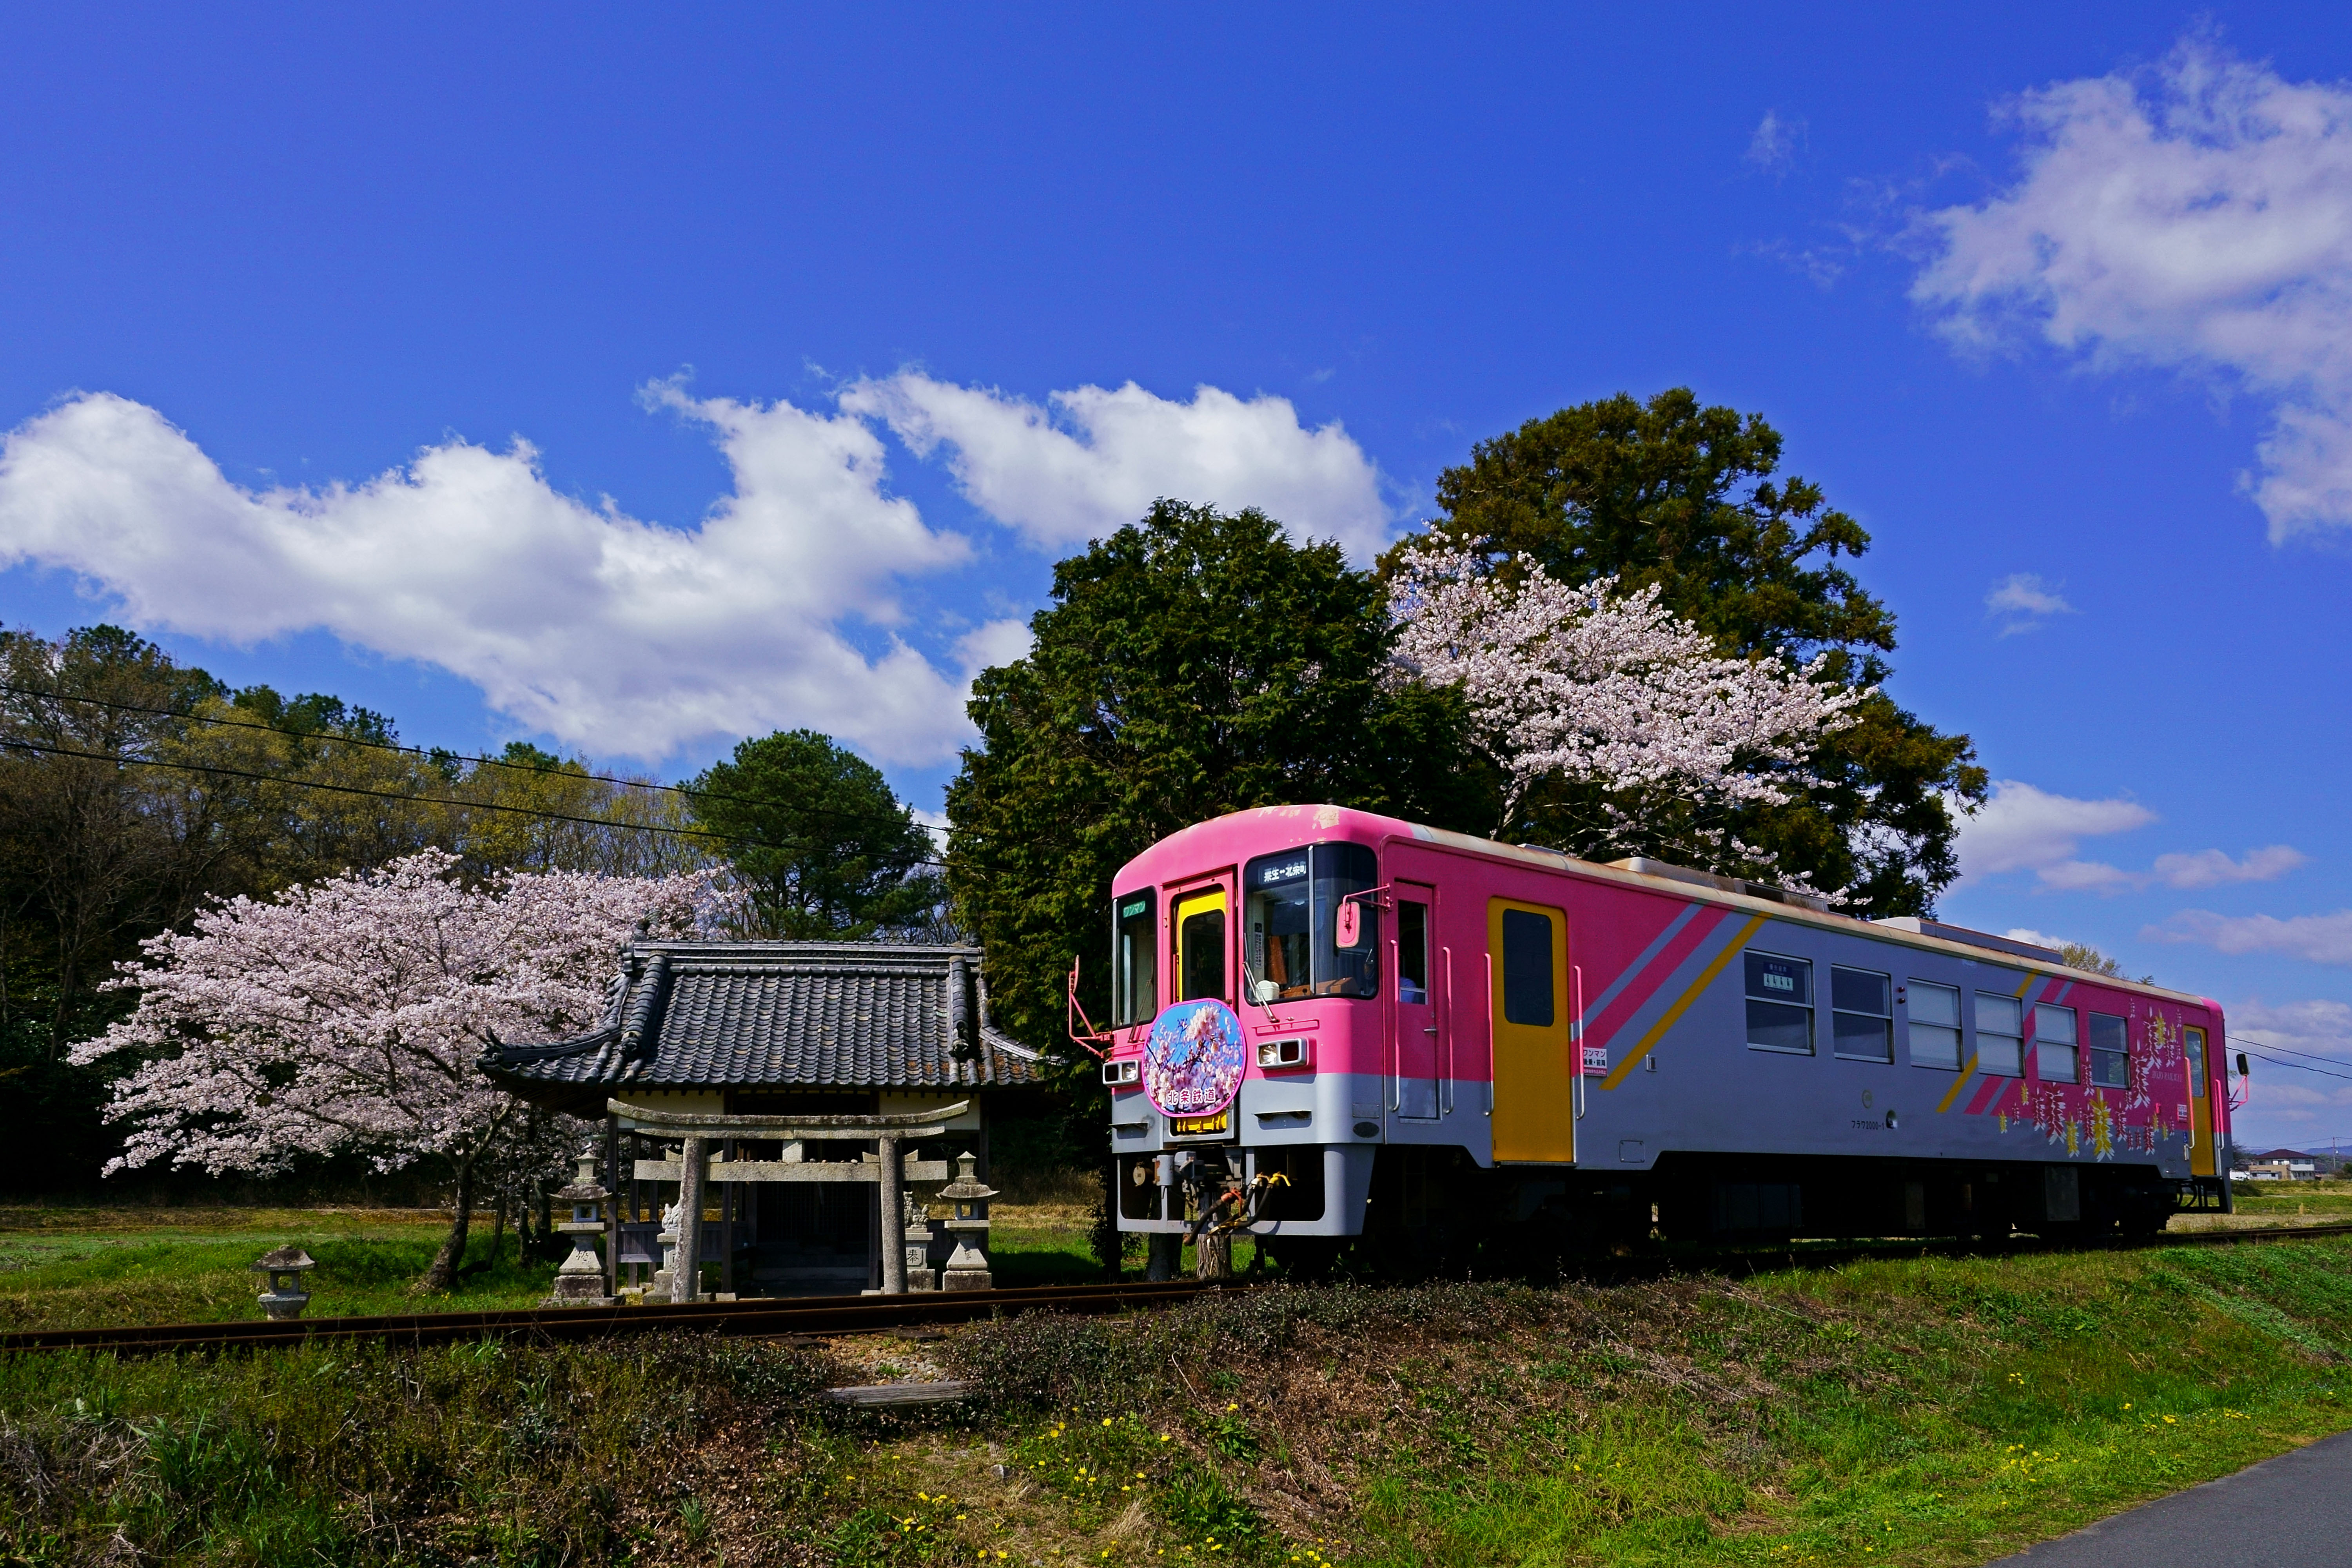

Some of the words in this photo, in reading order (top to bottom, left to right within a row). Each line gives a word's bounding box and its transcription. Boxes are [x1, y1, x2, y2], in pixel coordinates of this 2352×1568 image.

[1123, 902, 1145, 917] ワンマン
[1168, 1087, 1215, 1105] 北条鉄道
[1851, 1120, 1884, 1131] フラワ2000-1
[906, 1249, 919, 1263] 奉
